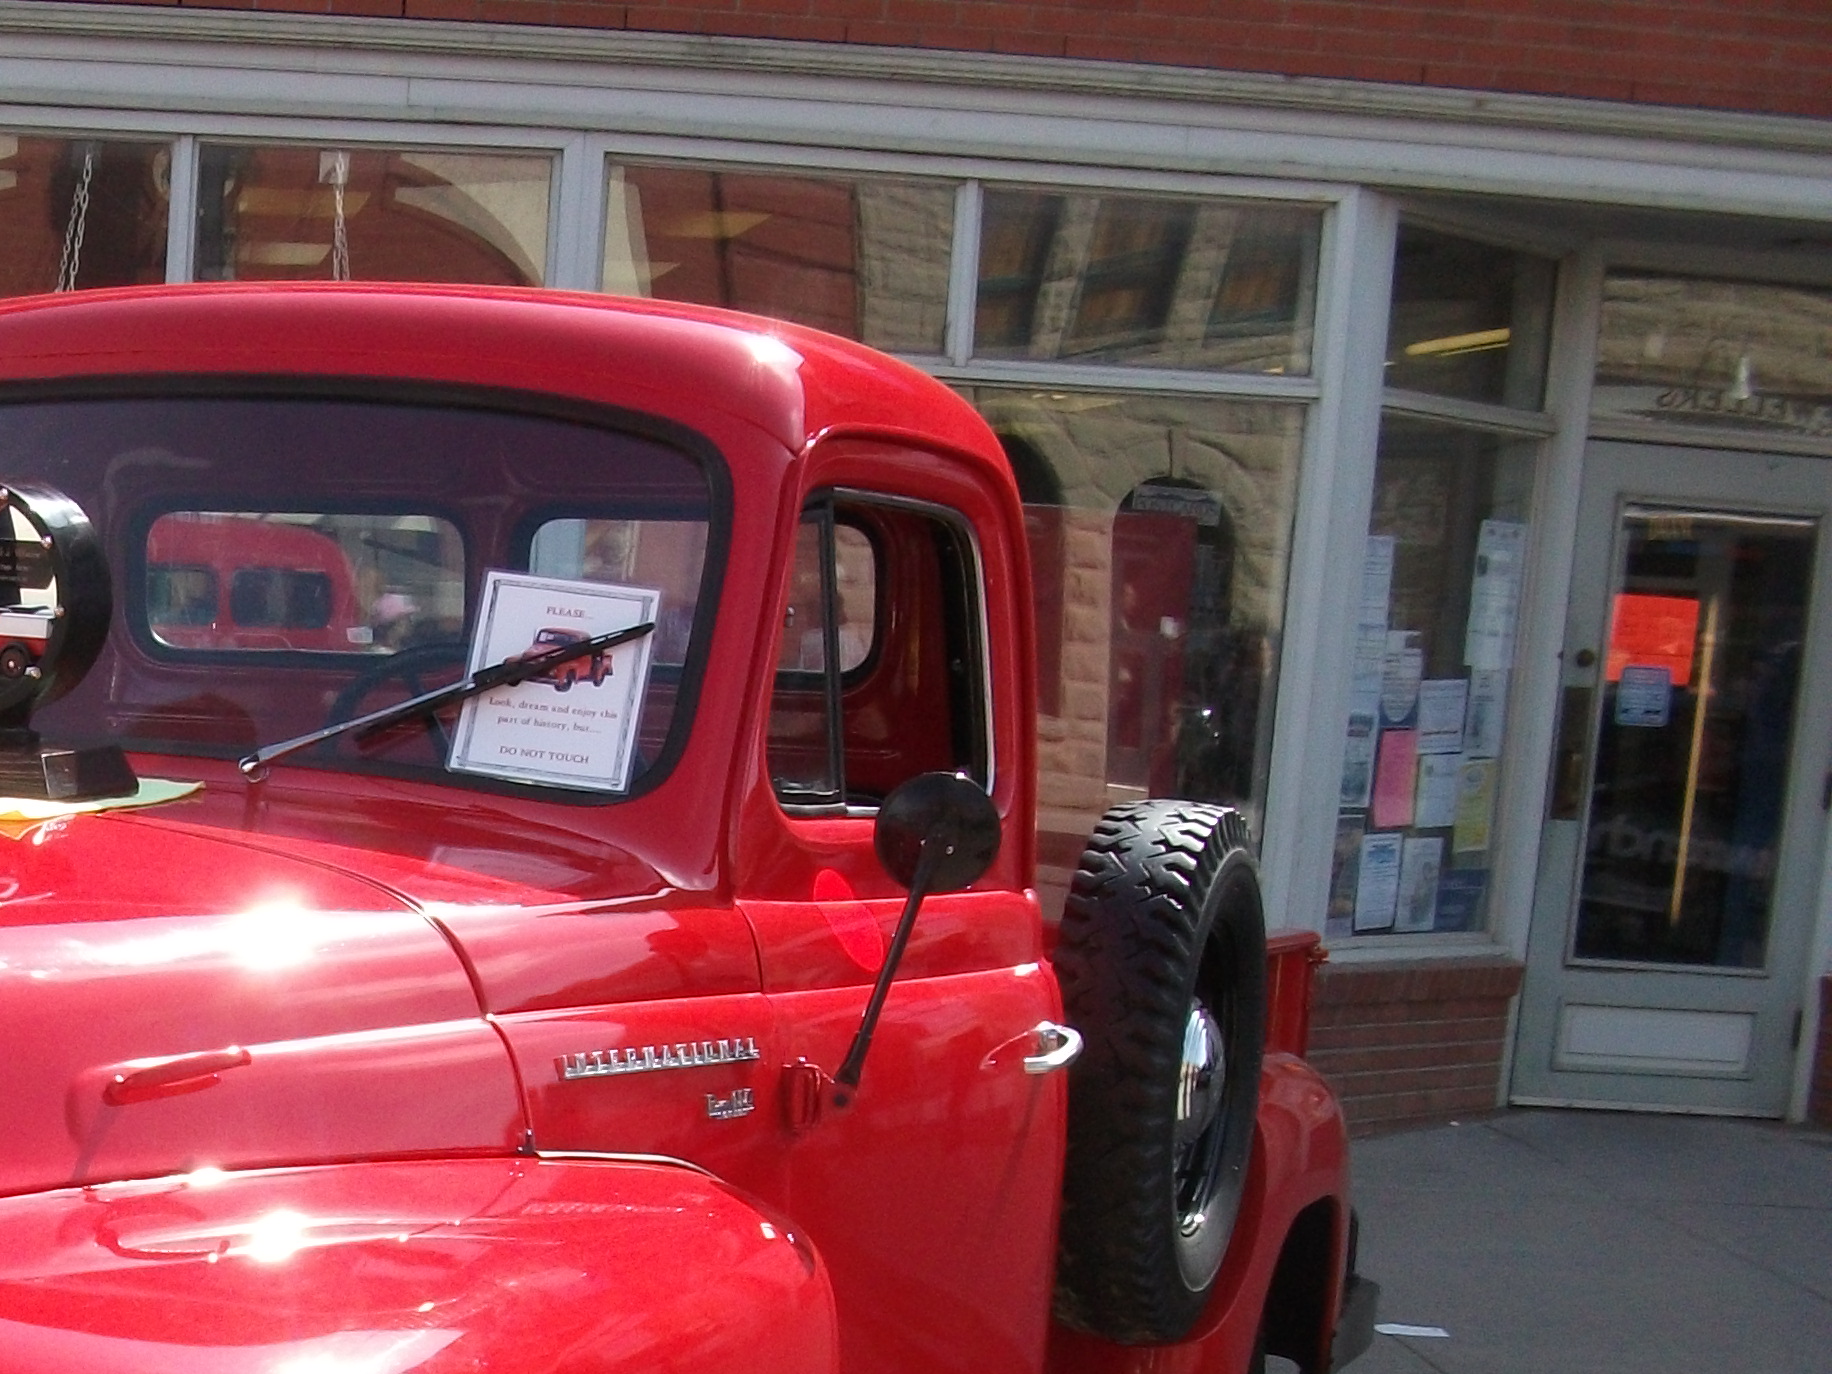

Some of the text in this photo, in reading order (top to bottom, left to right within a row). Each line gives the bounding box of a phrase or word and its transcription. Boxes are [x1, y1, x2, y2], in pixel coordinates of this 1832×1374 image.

[518, 700, 549, 712] dream
[551, 704, 569, 714] and
[571, 707, 598, 719] enjoy
[600, 708, 619, 720] this
[496, 715, 518, 725] part
[520, 717, 532, 726] of
[533, 717, 571, 732] history,
[499, 745, 590, 765] DO NOT TOUCH
[562, 1037, 761, 1080] INTERNATIONAL
